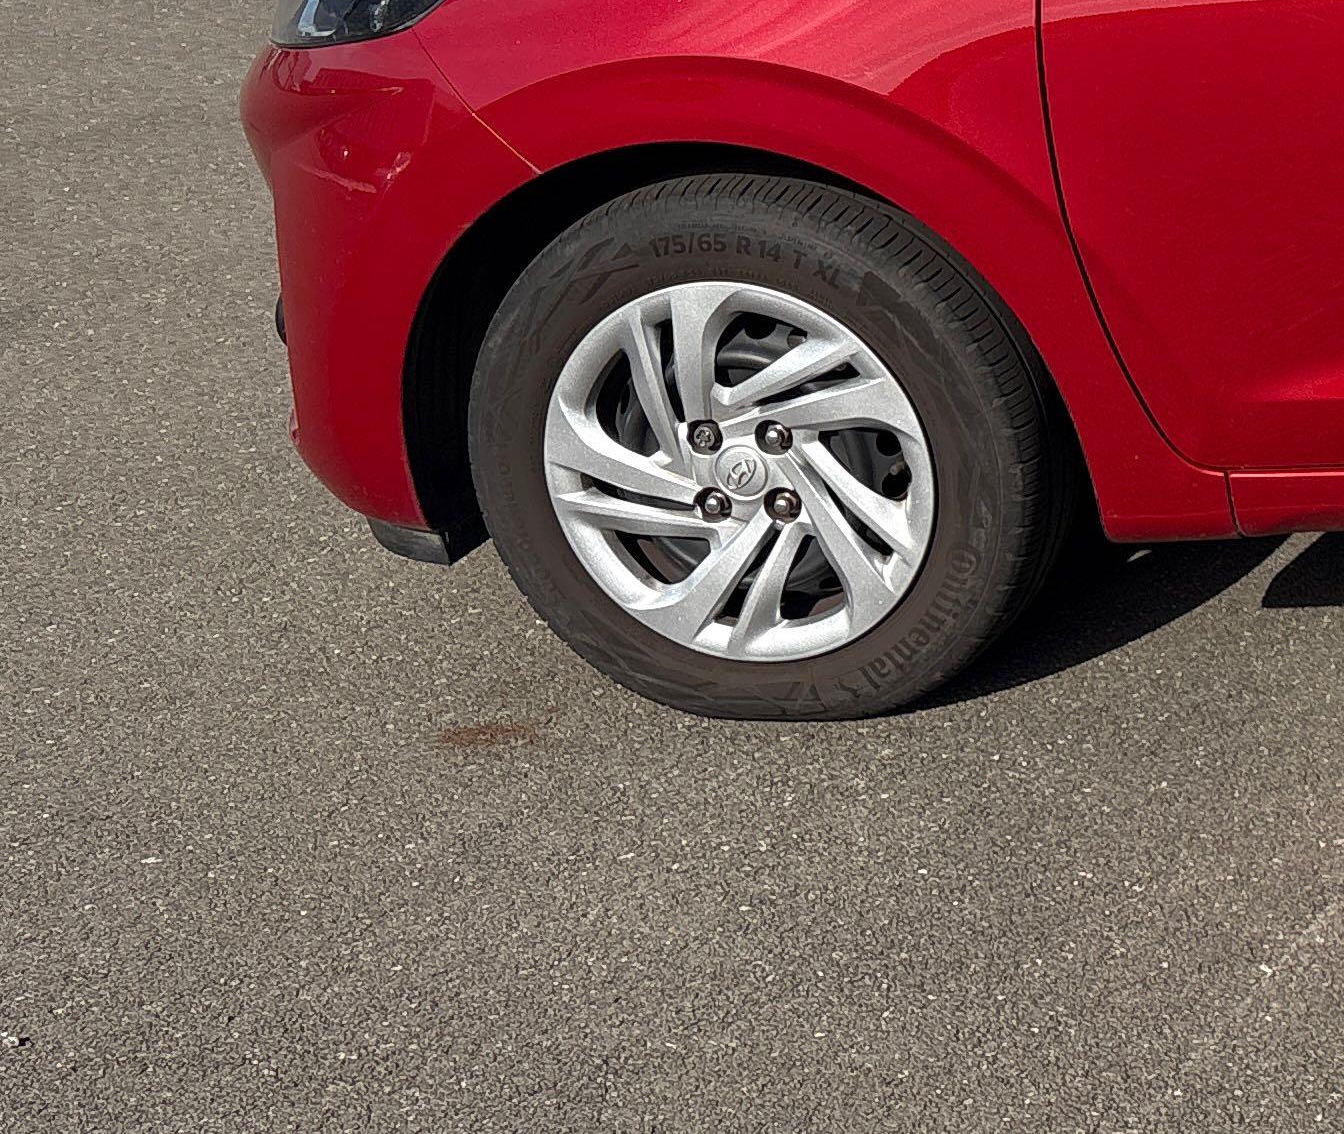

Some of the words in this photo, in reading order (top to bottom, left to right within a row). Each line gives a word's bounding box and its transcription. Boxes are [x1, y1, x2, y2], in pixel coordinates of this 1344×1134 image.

[649, 232, 728, 258] 175/65
[736, 235, 753, 256] R
[758, 240, 783, 263] 14
[793, 249, 808, 269] T
